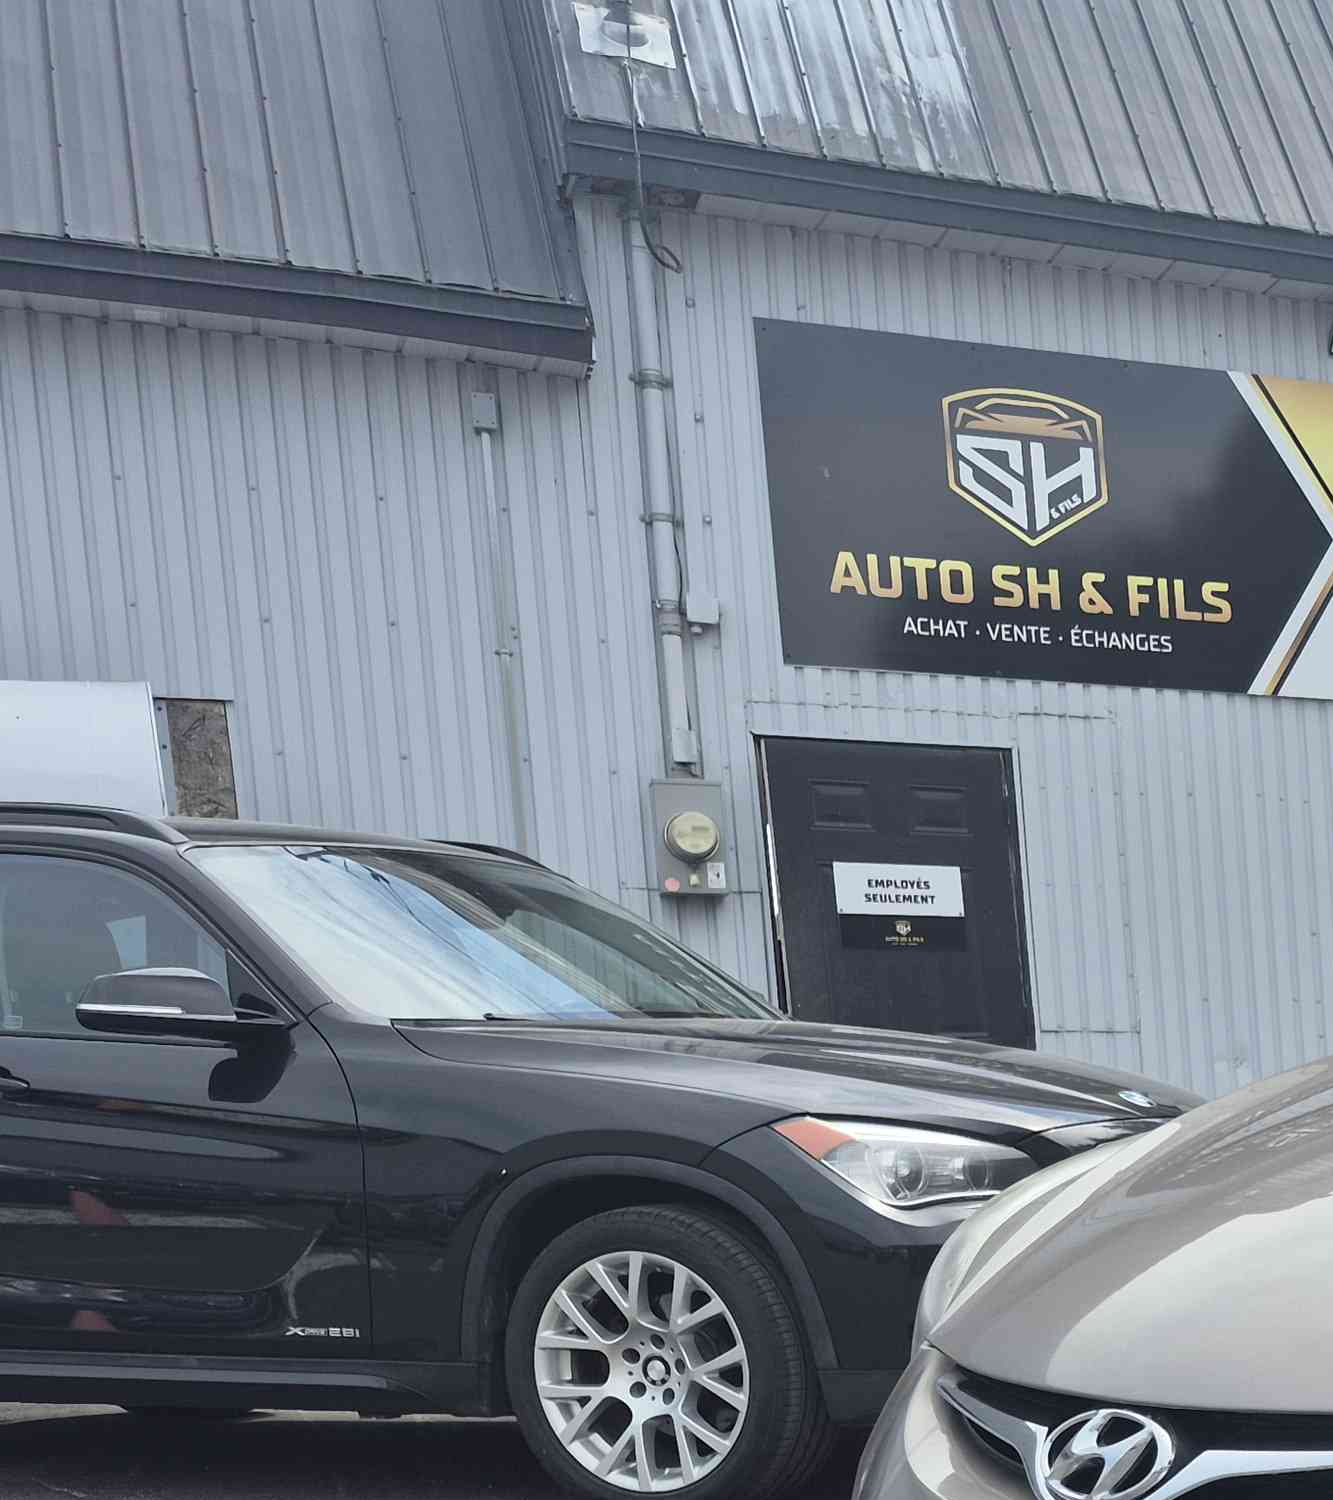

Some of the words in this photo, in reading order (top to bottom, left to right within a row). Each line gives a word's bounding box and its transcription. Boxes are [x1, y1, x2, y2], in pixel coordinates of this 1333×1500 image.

[956, 434, 1096, 531] SH
[1060, 494, 1082, 516] FILS
[830, 551, 975, 604] AUTO
[991, 564, 1062, 611] SH
[1079, 572, 1114, 615] &
[1127, 575, 1233, 624] FILS
[903, 616, 968, 639] ACHAT
[987, 623, 1051, 644] VENTE
[1071, 624, 1173, 654] ÉCHANGES
[864, 893, 935, 904] SEULEMENT
[867, 877, 930, 890] EMPLOYÉS
